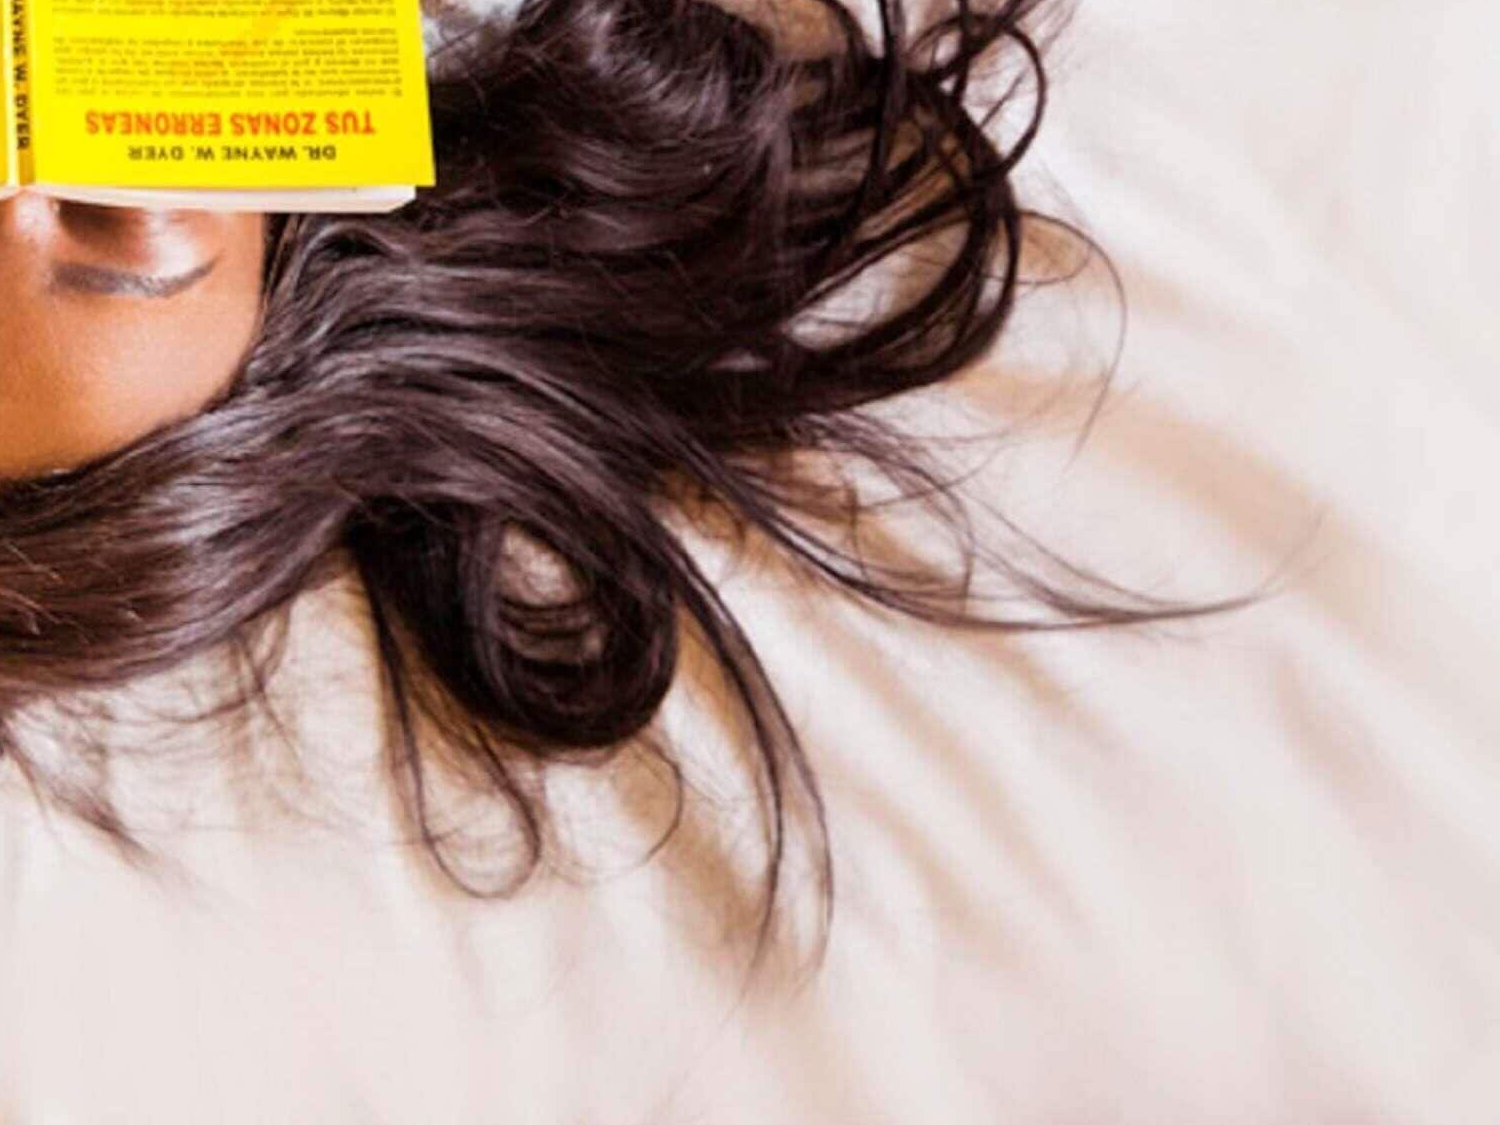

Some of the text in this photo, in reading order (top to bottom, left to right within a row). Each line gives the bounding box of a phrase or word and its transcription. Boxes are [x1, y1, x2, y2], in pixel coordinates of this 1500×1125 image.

[84, 110, 376, 137] TUS ZONAS ERRONEAS
[128, 146, 182, 161] DYER
[222, 145, 297, 161] WAYNE
